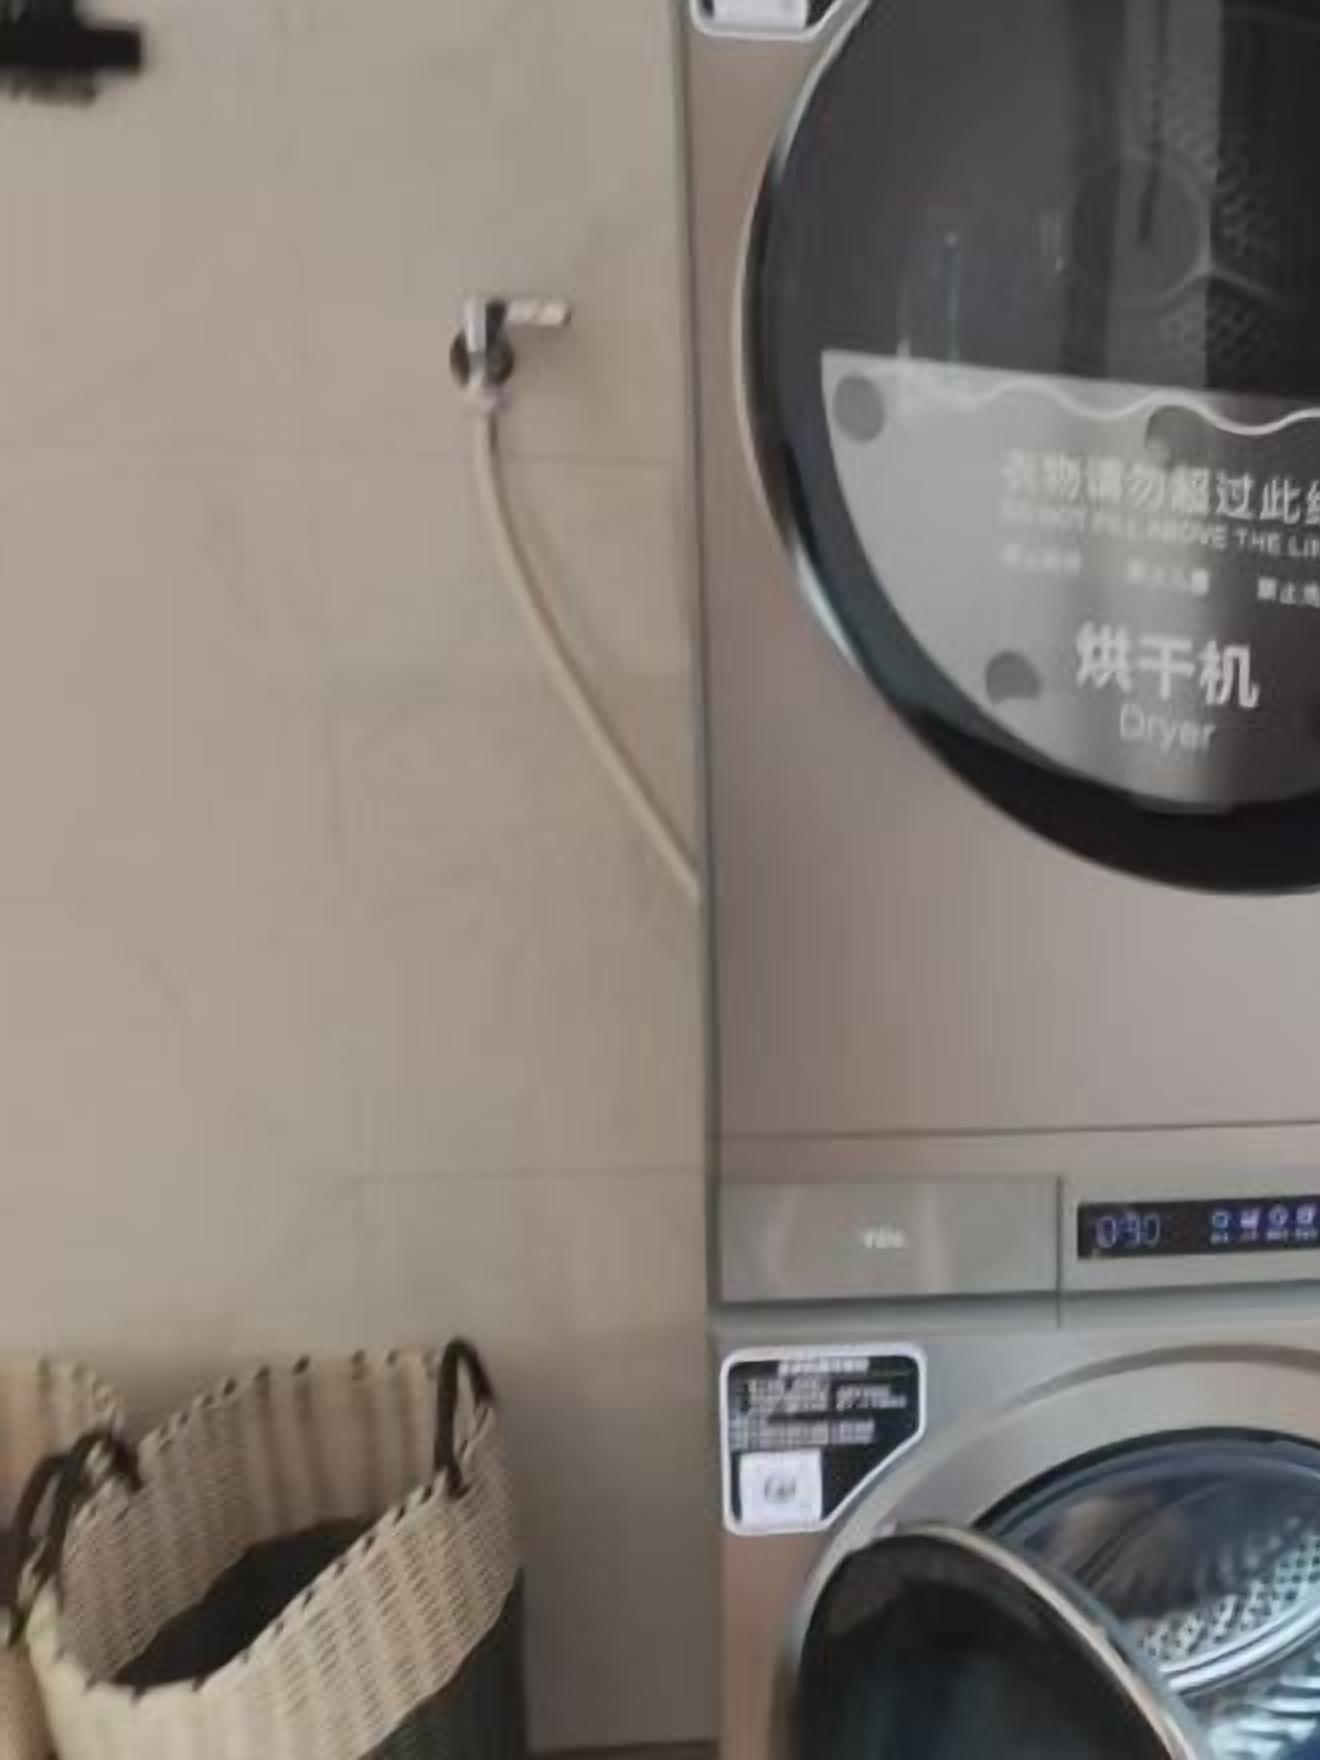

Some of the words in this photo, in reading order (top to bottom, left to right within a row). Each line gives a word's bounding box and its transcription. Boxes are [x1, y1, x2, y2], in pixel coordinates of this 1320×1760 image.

[1234, 527, 1281, 556] THE
[1075, 620, 1260, 708] 烘干机
[1119, 703, 1217, 756] Dryer
